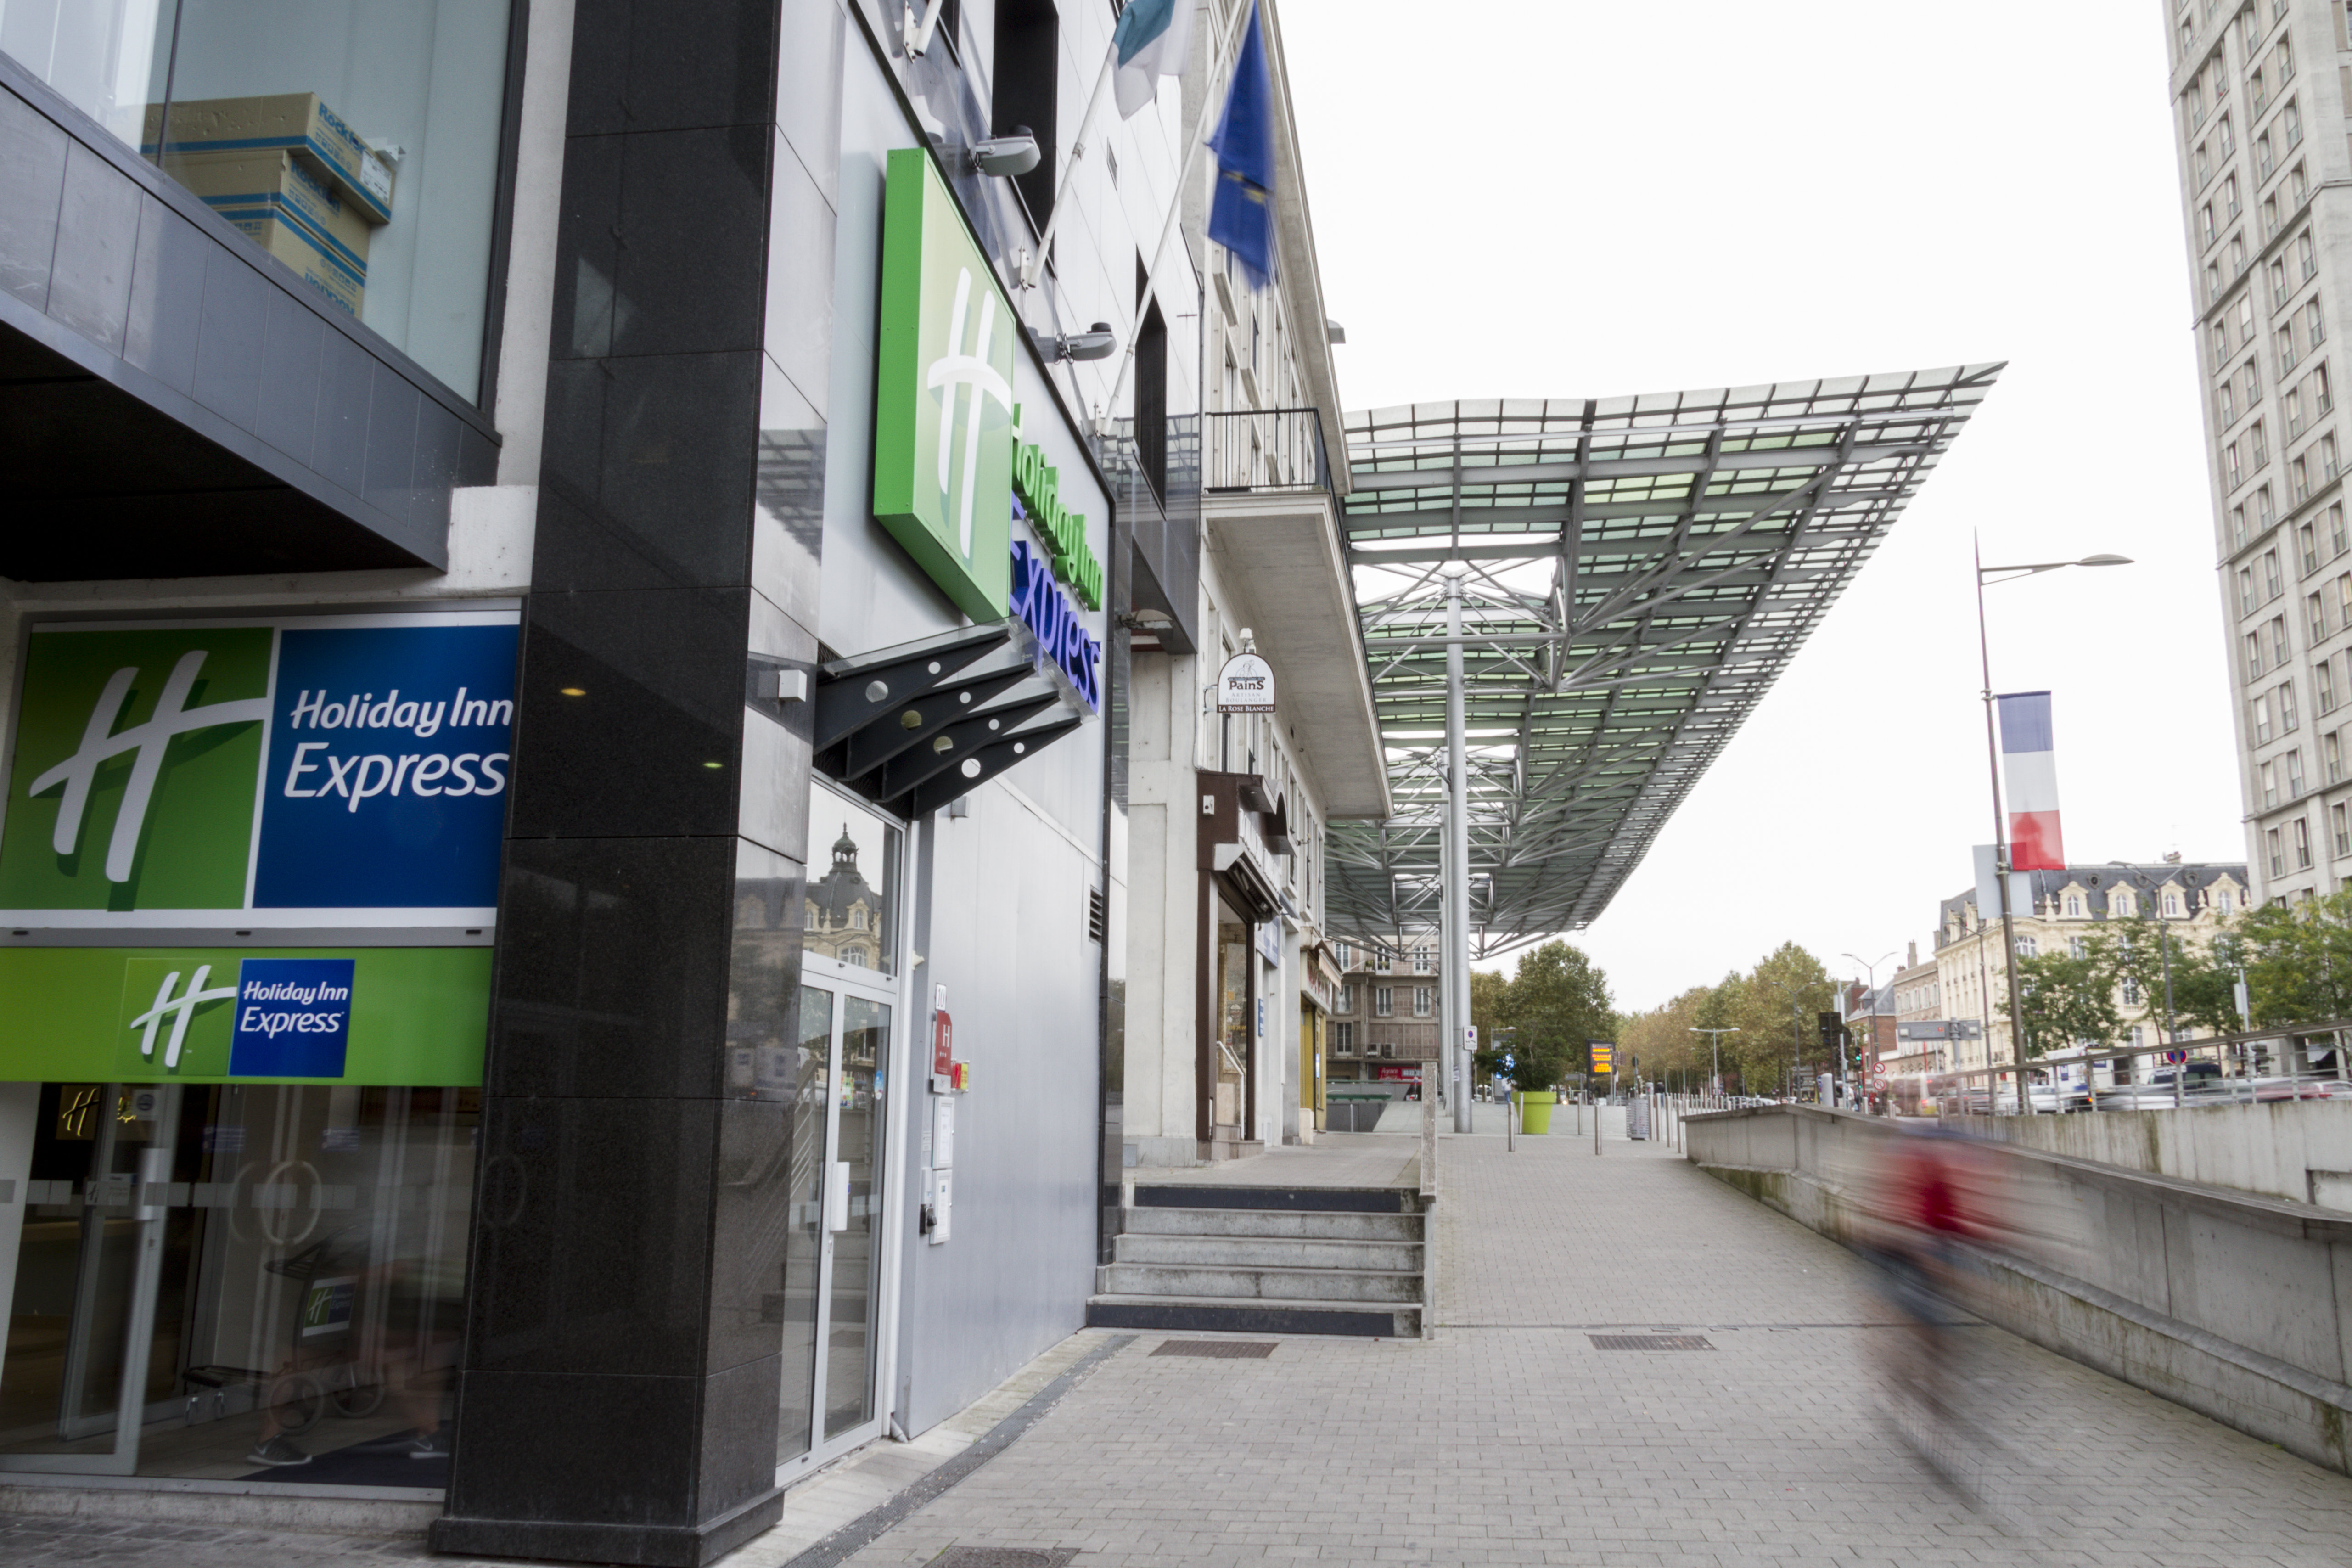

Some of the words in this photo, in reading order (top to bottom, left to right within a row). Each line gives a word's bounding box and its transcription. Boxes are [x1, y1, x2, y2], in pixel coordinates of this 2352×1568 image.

[1229, 680, 1264, 690] PainS
[290, 689, 445, 737] Holiday
[449, 687, 514, 727] Inn
[284, 742, 510, 813] Express
[243, 981, 316, 1005] Holiday
[318, 982, 348, 1001] Inn
[937, 987, 945, 1007] 10
[240, 1006, 342, 1039] Express
[942, 1024, 950, 1048] H
